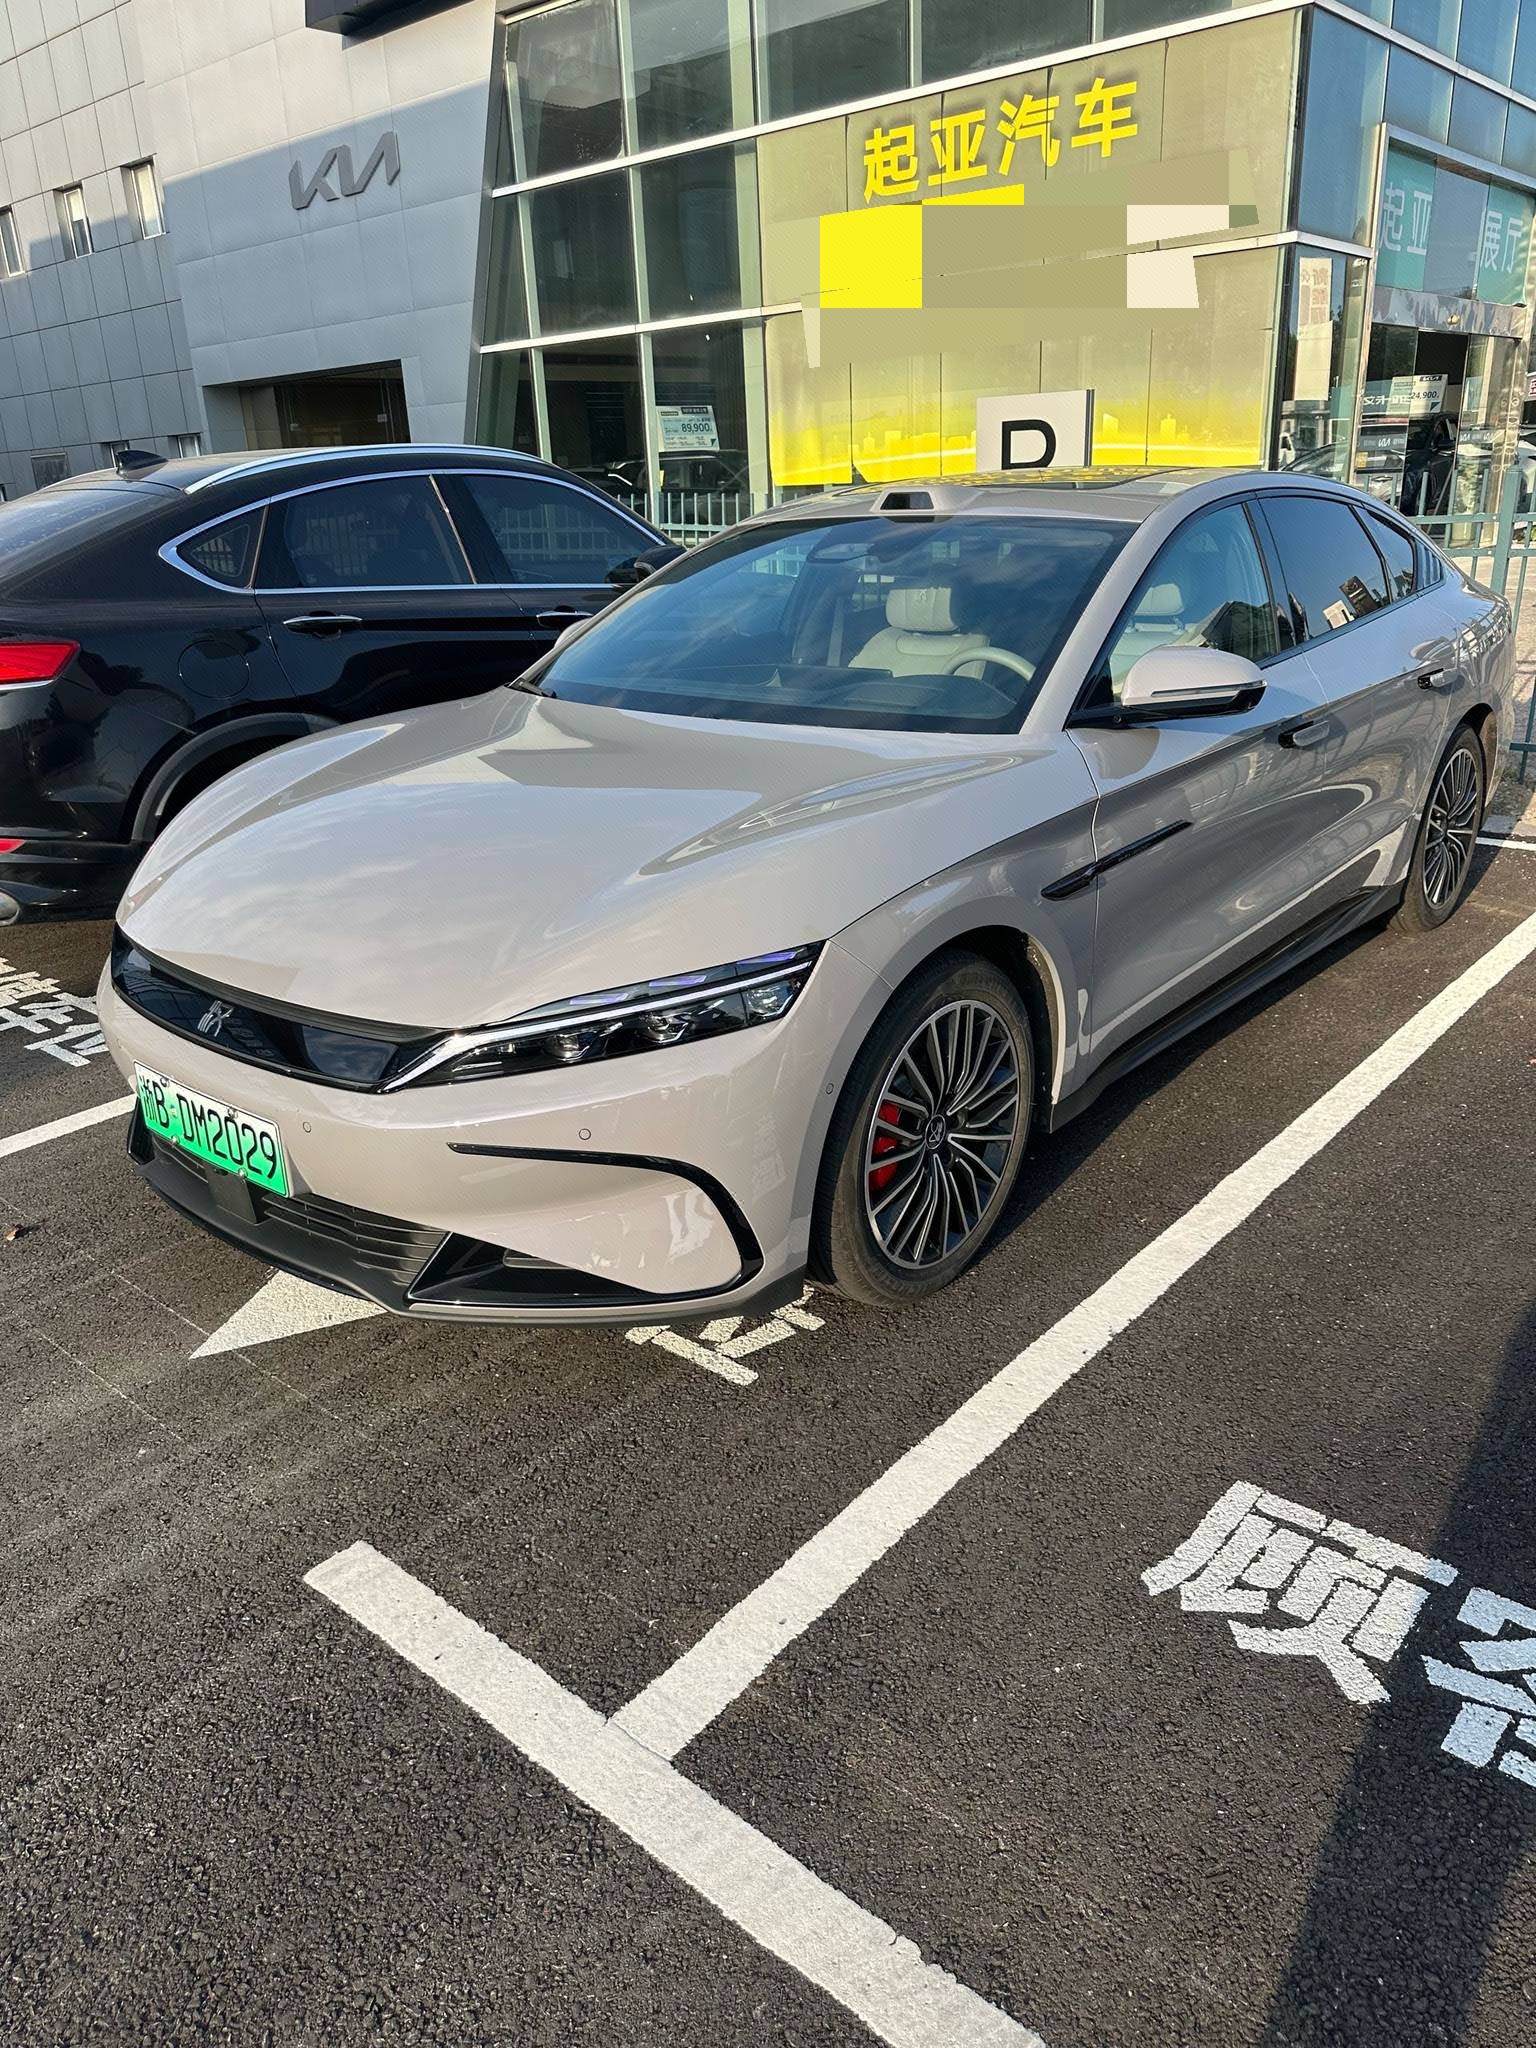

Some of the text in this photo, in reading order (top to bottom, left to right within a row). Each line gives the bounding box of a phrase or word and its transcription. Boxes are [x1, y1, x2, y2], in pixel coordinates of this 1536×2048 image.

[289, 131, 400, 211] KIA
[863, 77, 1139, 204] 起亚汽车
[681, 422, 710, 434] 89,900
